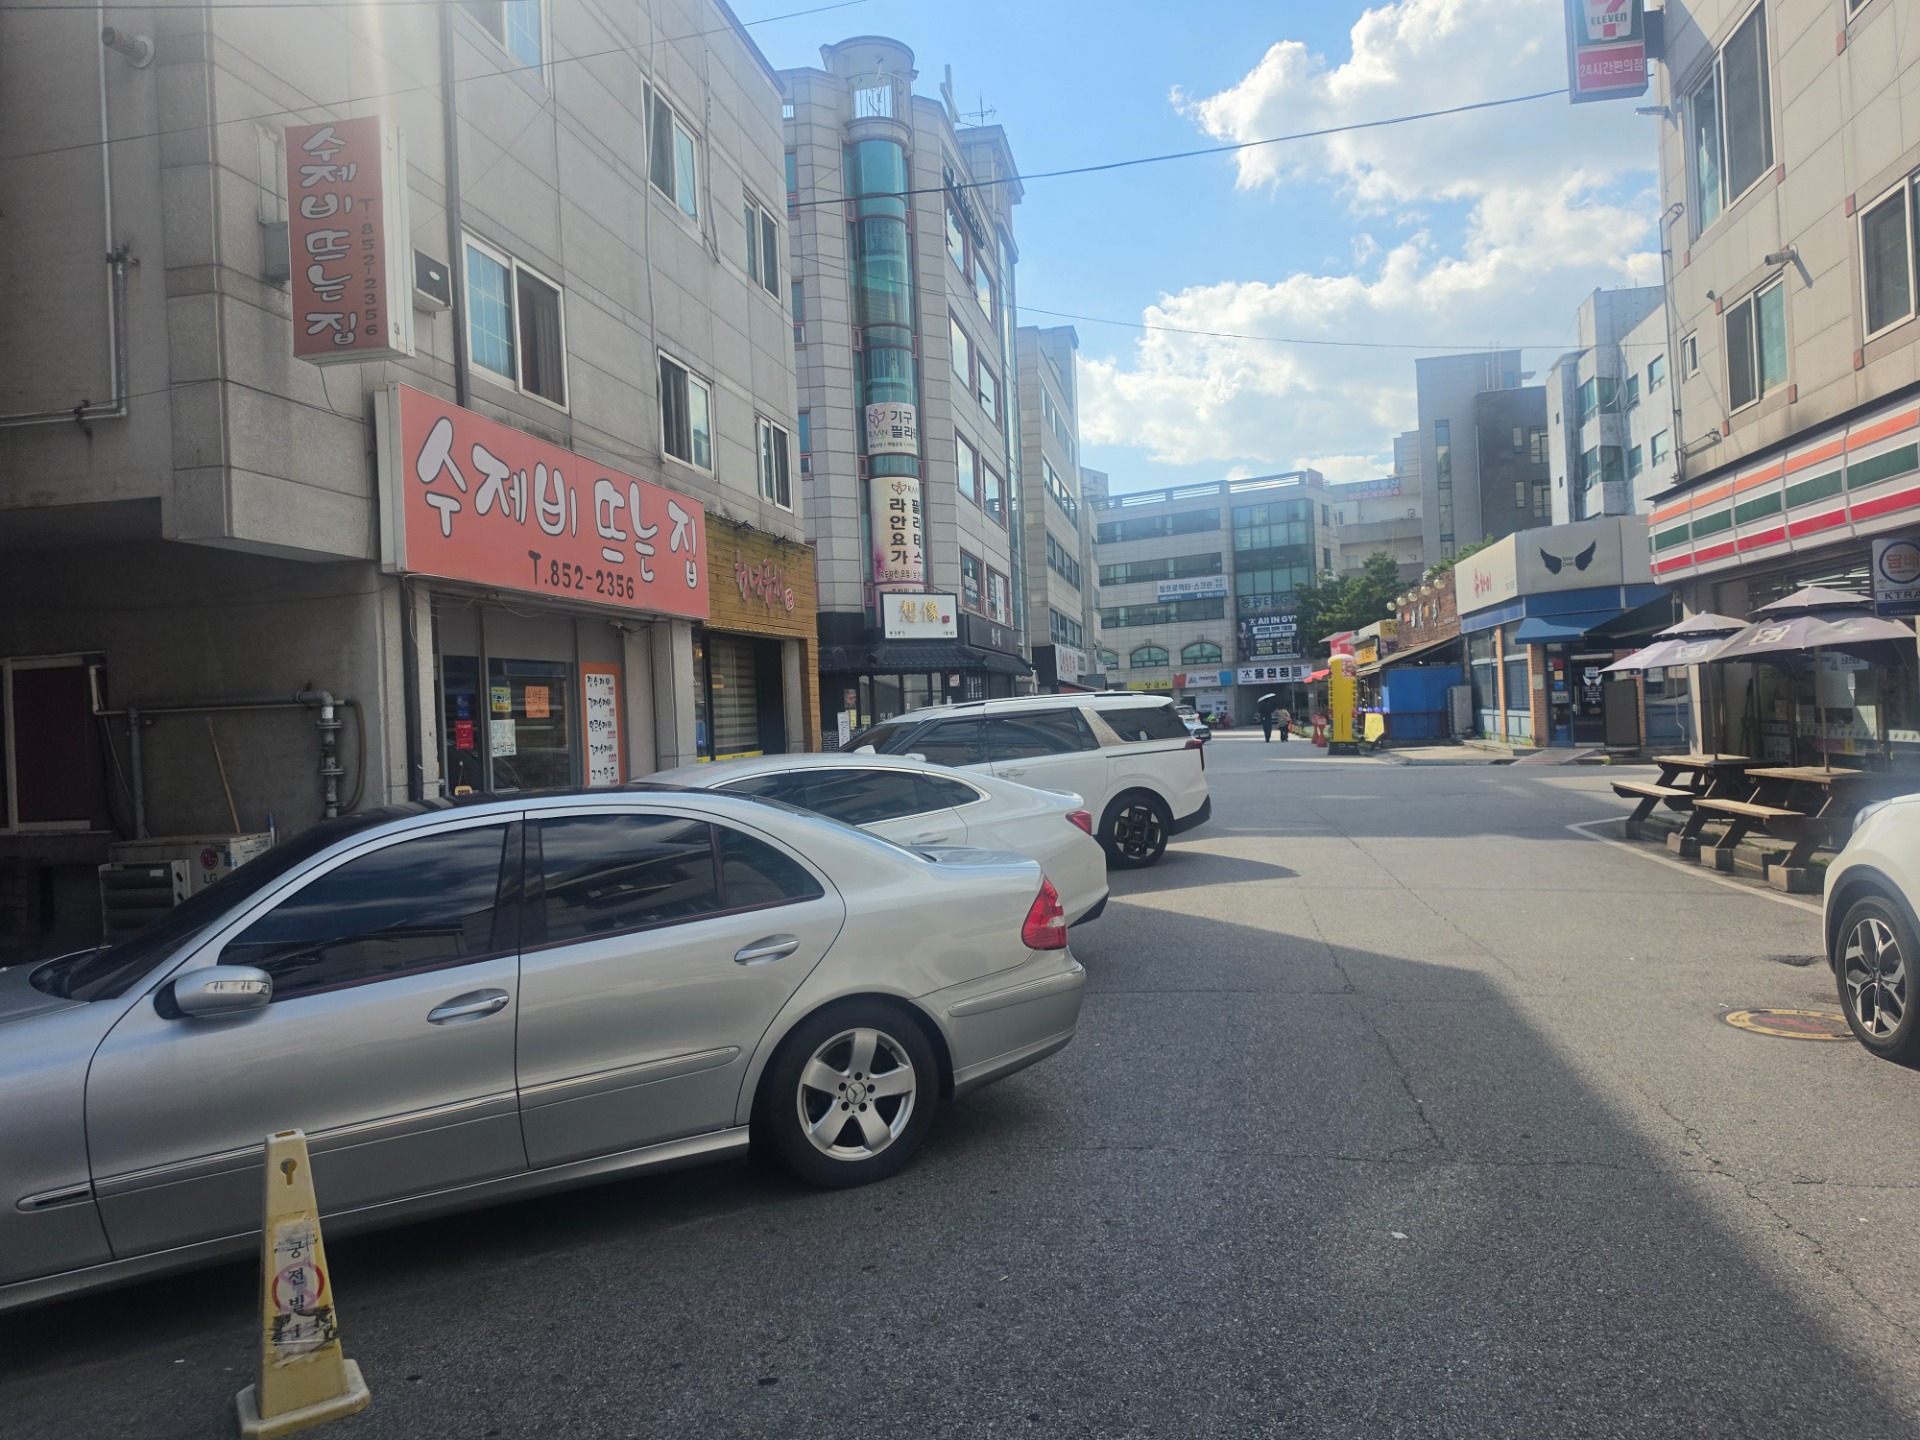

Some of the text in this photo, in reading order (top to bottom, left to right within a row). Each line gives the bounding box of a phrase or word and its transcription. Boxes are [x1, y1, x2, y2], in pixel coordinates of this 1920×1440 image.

[1580, 57, 1643, 77] 24시간편의점
[300, 126, 358, 219] 수제비
[305, 312, 358, 345] 집
[891, 410, 912, 424] 기구
[416, 416, 579, 538] 수제비
[667, 499, 699, 589] 집
[889, 498, 908, 565] 라안요가
[528, 550, 635, 600] T.852-2356
[203, 873, 218, 884] LG
